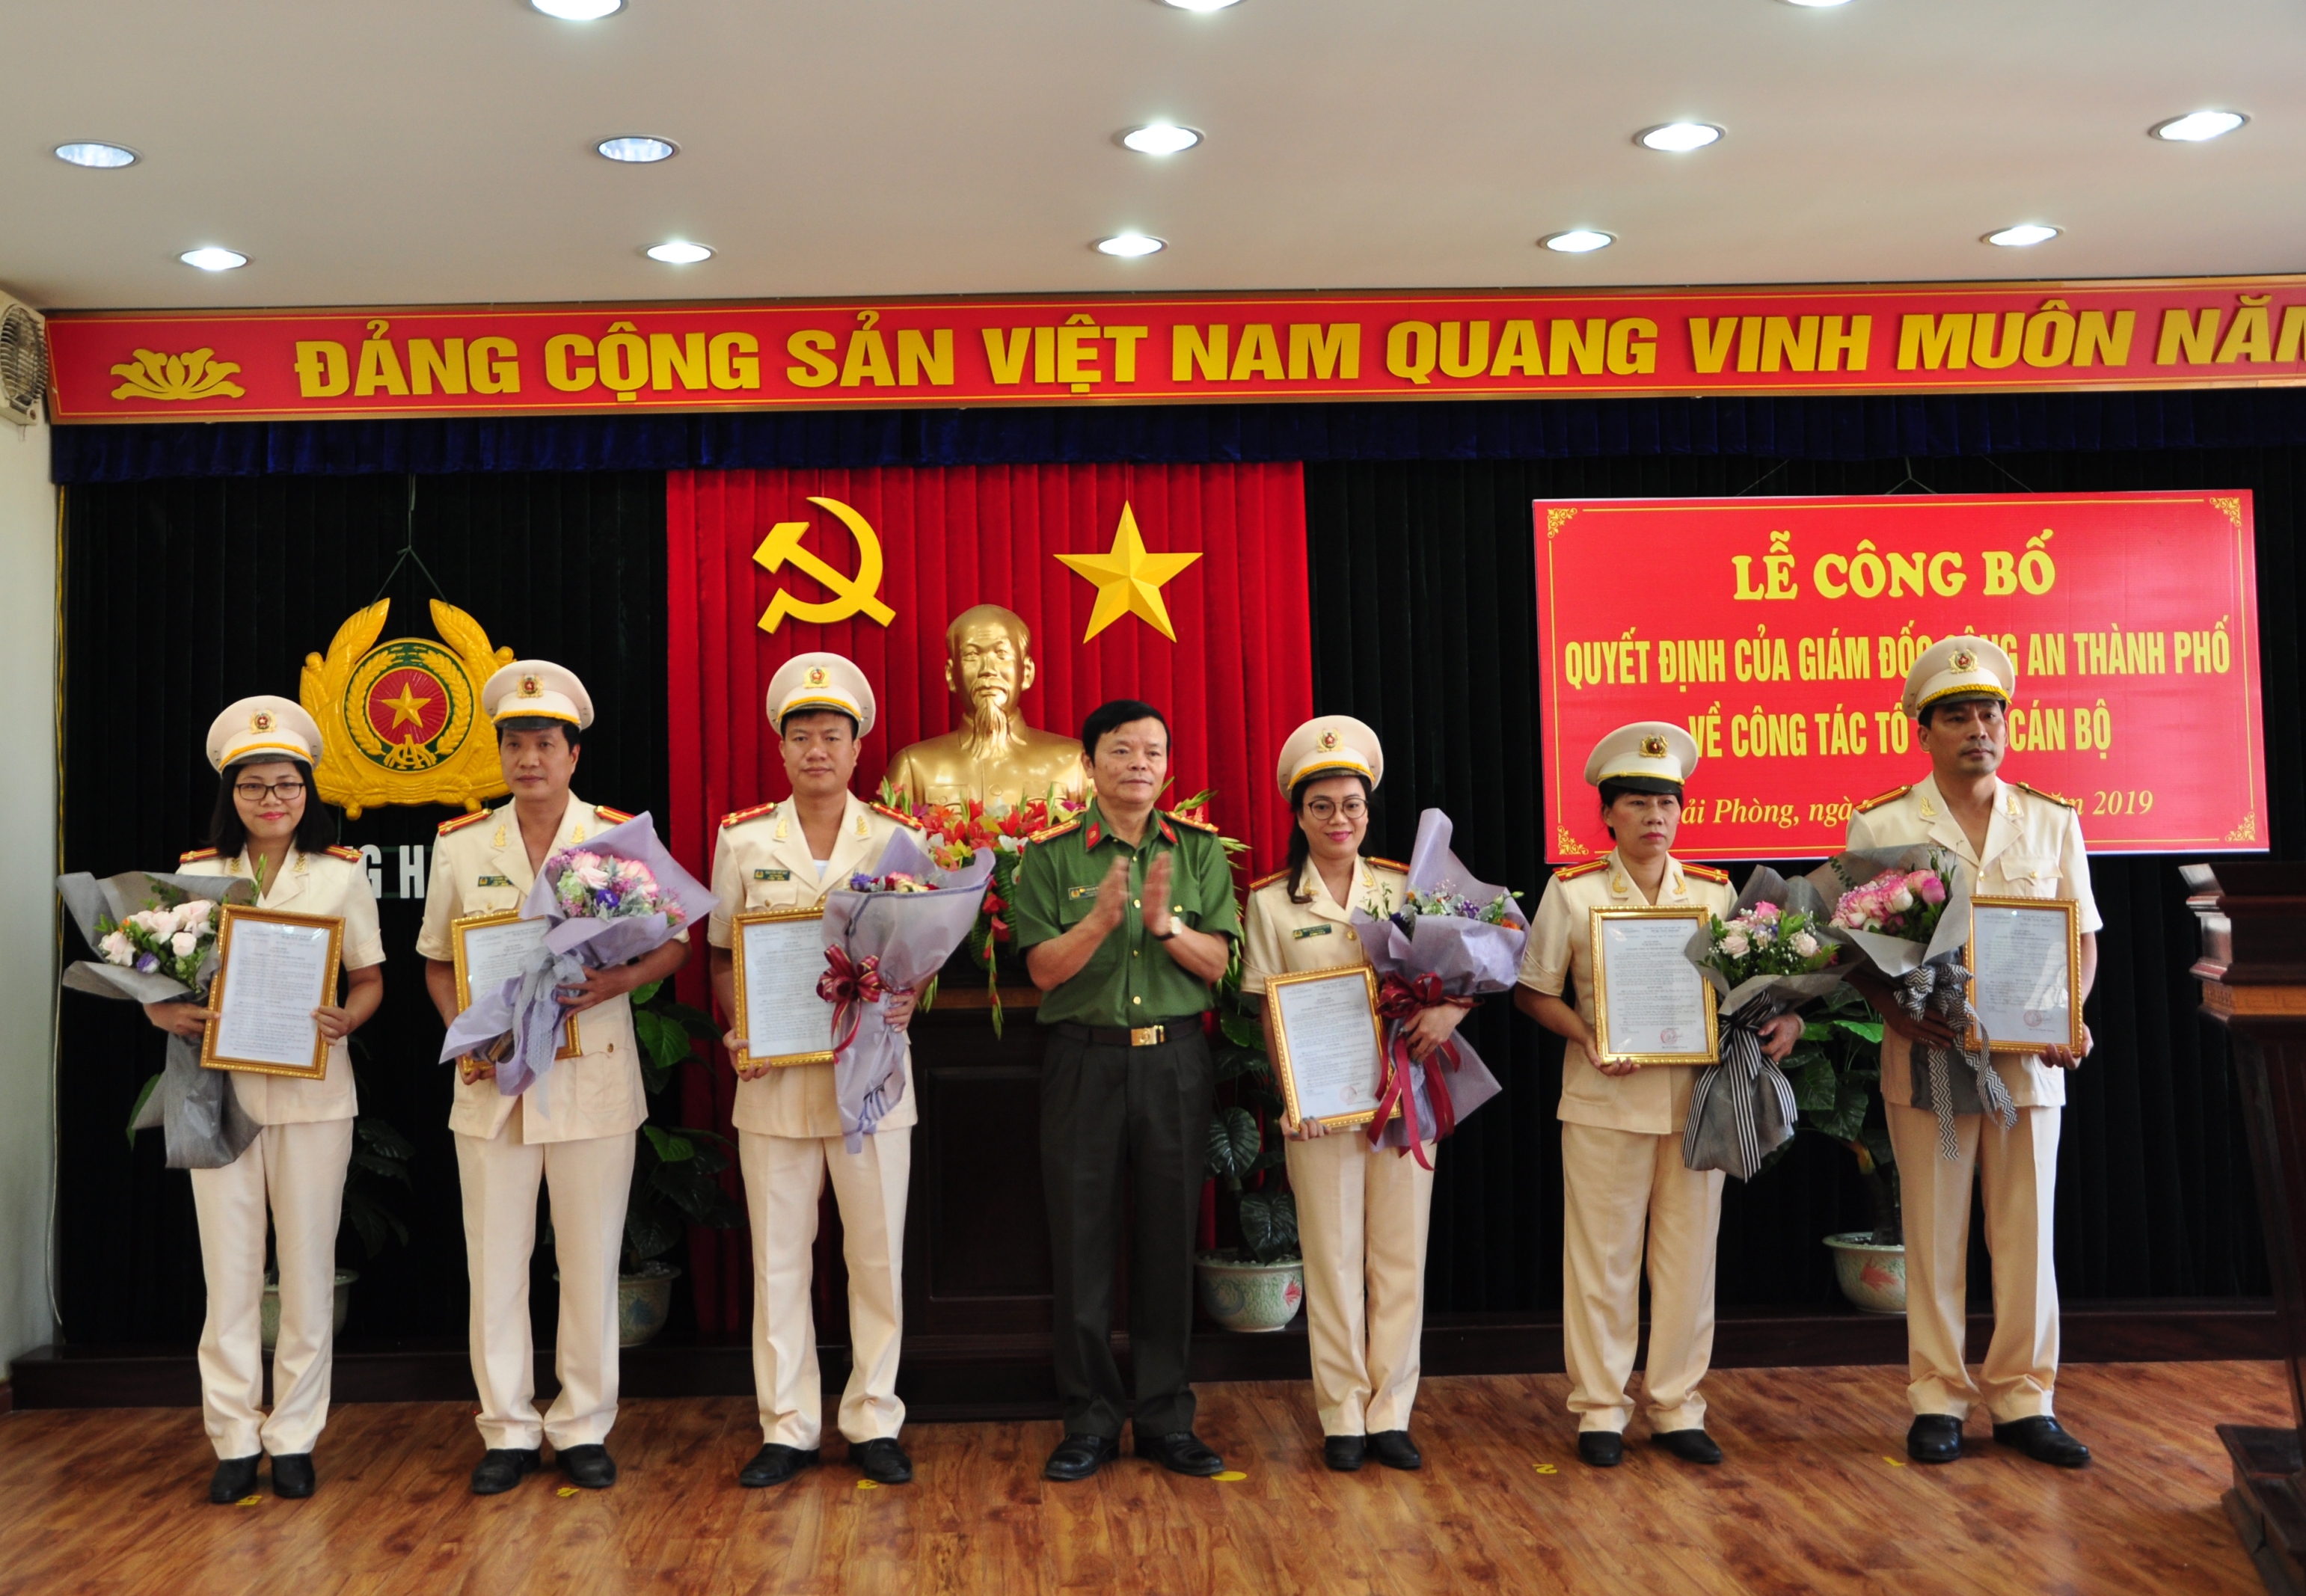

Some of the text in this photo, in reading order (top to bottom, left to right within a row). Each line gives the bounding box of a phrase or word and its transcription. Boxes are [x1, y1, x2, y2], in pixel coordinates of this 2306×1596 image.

[295, 319, 521, 398] ĐẢNG
[545, 321, 760, 402] CỘNG
[786, 310, 954, 387] SẢN
[981, 313, 1147, 393] VIỆT
[1172, 322, 1361, 382] NAM
[1386, 318, 1658, 384] QUANG
[1689, 315, 1871, 373] VINH
[1897, 299, 2135, 370] MUÔN
[1732, 528, 2055, 600] LỄ CÔNG BỐ
[1564, 627, 1650, 690] QUYẾT
[1658, 639, 1726, 693] ĐỊNH
[1735, 624, 1791, 682] CỦA
[1798, 628, 1871, 681] GIÁM
[2027, 632, 2067, 676] AN
[2073, 622, 2166, 676] THÀNH
[2174, 615, 2230, 675] PHỐ
[1688, 701, 1723, 758] VỀ
[1731, 705, 1807, 758] CÔNG
[1815, 703, 1867, 757] TÁC
[2008, 699, 2066, 752] CÁN
[2074, 699, 2112, 759] BỘ
[1678, 798, 1706, 824] ải
[1714, 797, 1800, 829] Phòng,
[1809, 796, 1853, 827] ngà
[2092, 790, 2154, 815] 2019
